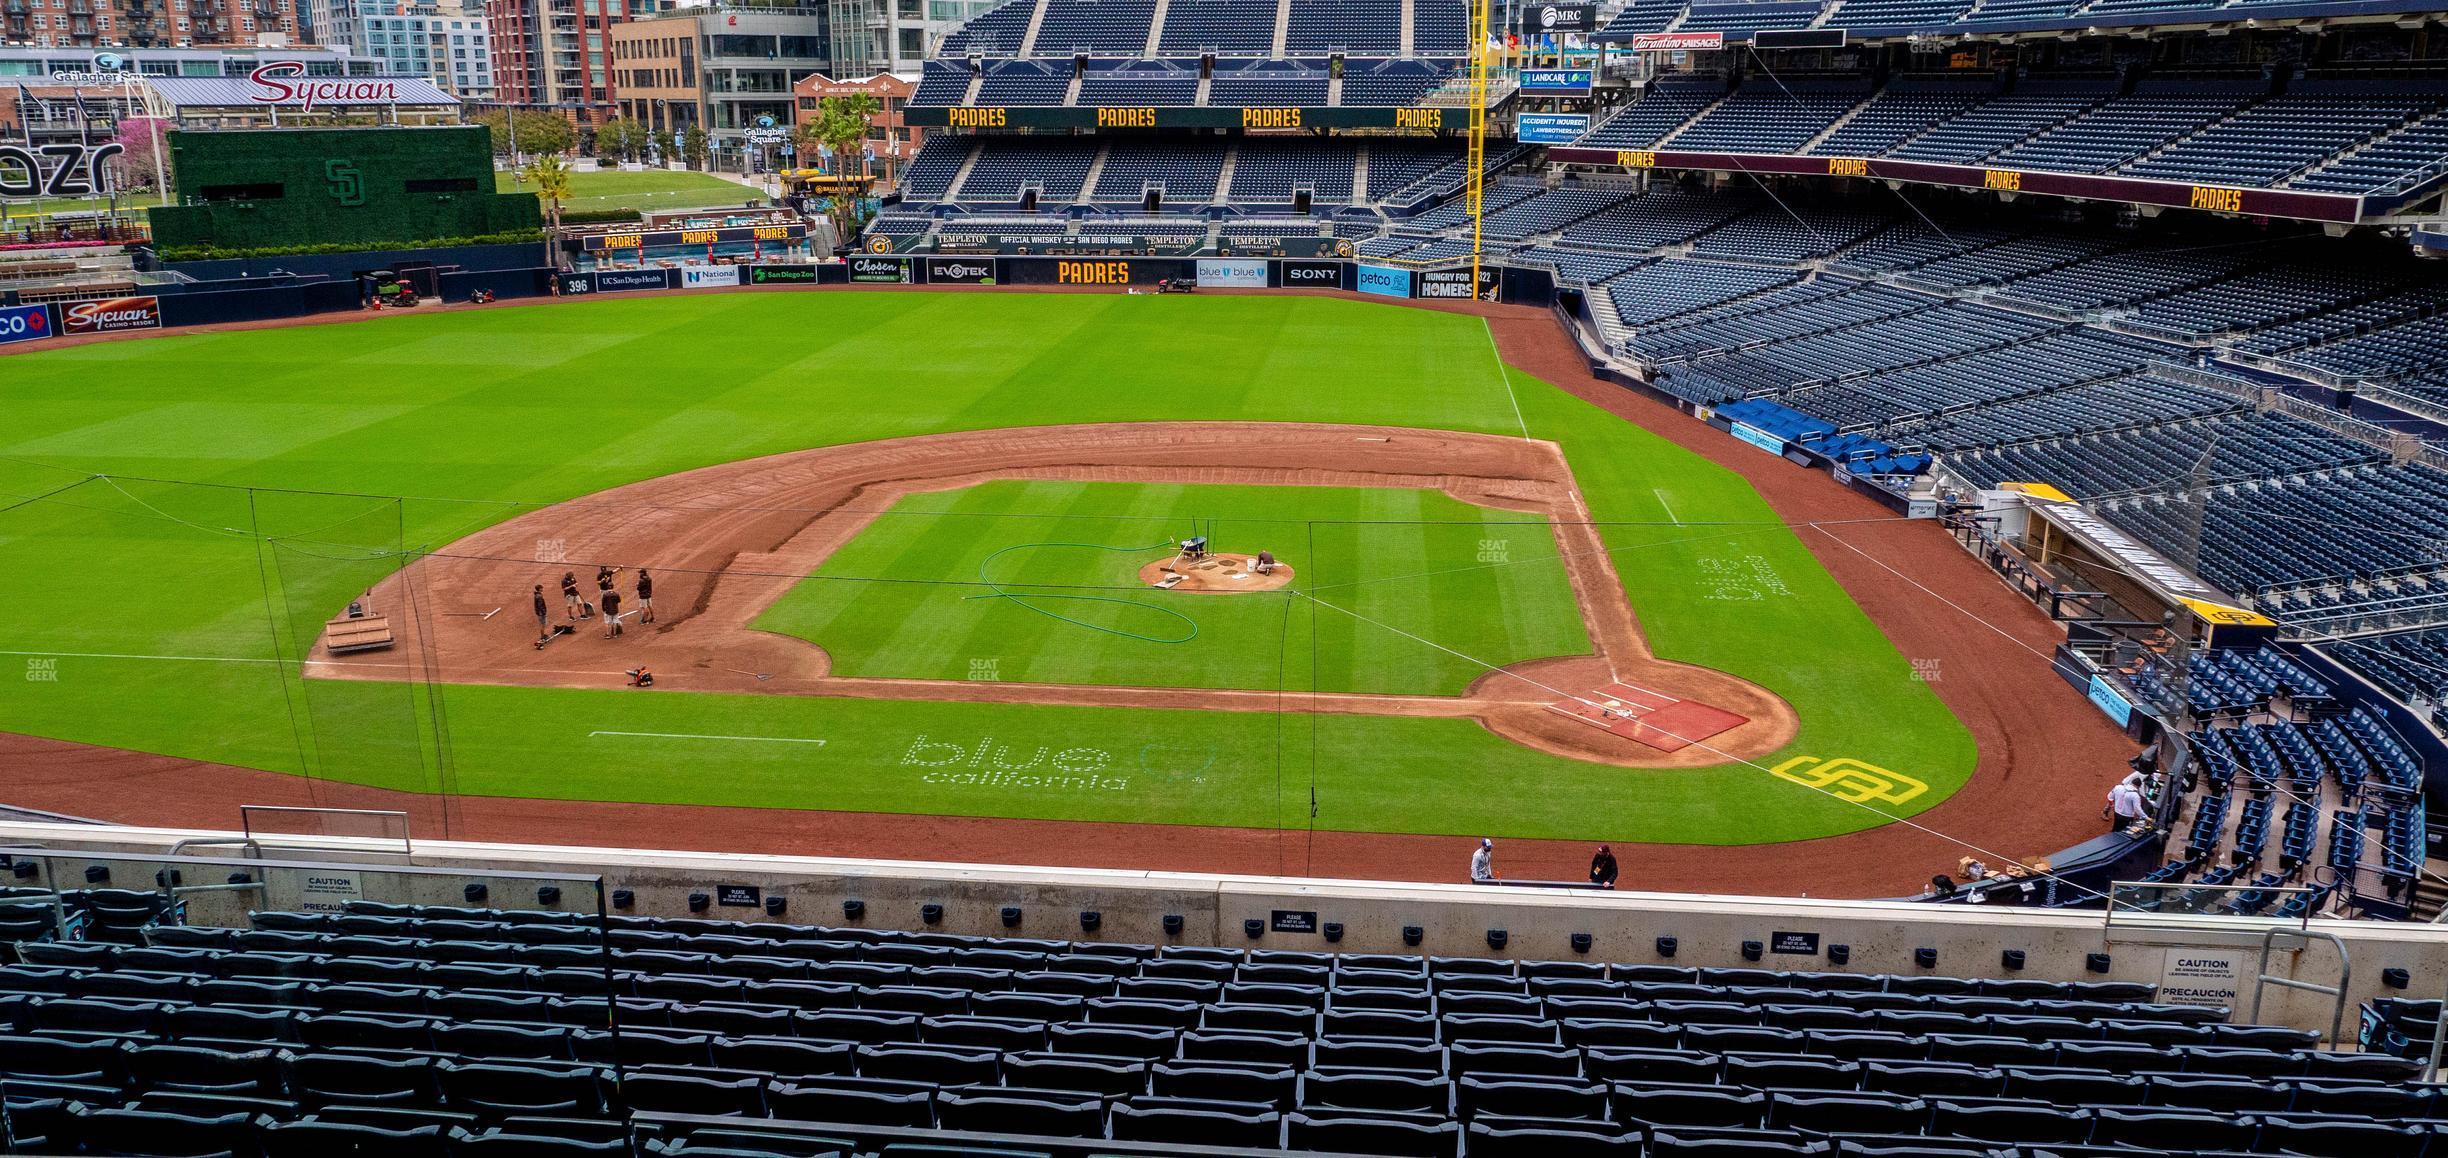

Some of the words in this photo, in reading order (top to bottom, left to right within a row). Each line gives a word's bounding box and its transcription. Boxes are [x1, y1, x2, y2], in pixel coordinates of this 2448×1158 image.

[1557, 10, 1581, 21] MRC
[1635, 35, 1681, 50] Tarantino
[1681, 37, 1720, 48] SAUSAGES
[53, 70, 119, 84] Gallagher
[1532, 73, 1566, 84] LANDCARE
[1568, 73, 1589, 83] LOGIC
[250, 61, 401, 113] Sycuan
[948, 107, 1006, 127] PADRES
[1098, 107, 1155, 127] PADRES
[1242, 107, 1301, 128] PADRES
[1395, 108, 1441, 128] PADRES
[1521, 118, 1556, 126] ACCIDENT?
[744, 128, 787, 136] Gallagher
[750, 136, 781, 145] Square
[1617, 151, 1655, 168] PADRES
[1829, 158, 1867, 177] PADRES
[1985, 170, 2021, 191] PADRES
[2191, 187, 2241, 212] PADRES
[682, 231, 719, 244] PADRES
[754, 227, 788, 240] PADRES
[938, 235, 988, 244] TEMPLETON
[1000, 236, 1030, 244] OFFICIAL
[1031, 236, 1061, 244] WHISKEY
[1078, 236, 1090, 244] SAN
[1091, 236, 1108, 244] DIEGO
[1110, 236, 1132, 244] PADRES
[604, 235, 643, 249] PADRES
[1145, 236, 1196, 246] TEMPLETON
[1229, 237, 1281, 247] TEMPLETON
[854, 259, 897, 272] Chosen
[934, 264, 988, 279] EVOTEK
[1199, 267, 1221, 276] blue
[1233, 267, 1255, 276] blue
[703, 269, 736, 278] National
[768, 270, 780, 278] San
[781, 271, 800, 279] Diego
[801, 271, 815, 279] Zoo
[1058, 261, 1129, 284] PADRES
[1290, 269, 1337, 280] SONY
[1360, 272, 1391, 286] petco
[1425, 273, 1455, 283] HUNGRY
[1455, 273, 1470, 282] FOR
[1479, 271, 1491, 282] 322
[569, 279, 588, 293] 396
[602, 277, 612, 285] UC
[613, 277, 625, 285] San
[625, 276, 642, 285] Diego
[642, 275, 662, 283] Health
[1422, 282, 1473, 297] HOMERS
[68, 303, 150, 330] Sycuan
[2091, 683, 2110, 705] petco
[901, 734, 1111, 772] blue
[922, 771, 1131, 790] california
[308, 877, 351, 886] CAUTION
[2177, 959, 2229, 968] CAUTION
[2162, 987, 2236, 998] PRECAUCIÓN
